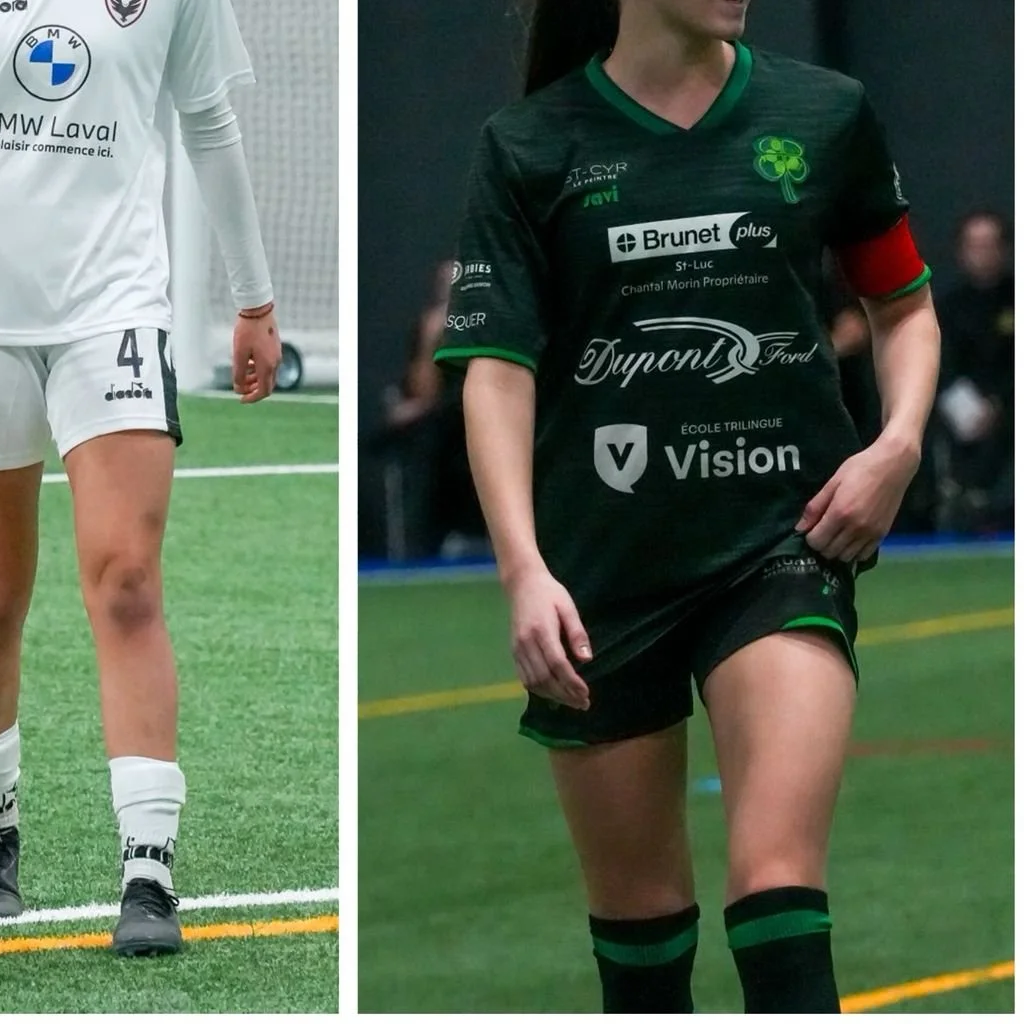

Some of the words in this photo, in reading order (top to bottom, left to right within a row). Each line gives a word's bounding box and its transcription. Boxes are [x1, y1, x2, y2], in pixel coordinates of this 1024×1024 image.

[25, 28, 82, 50] BMW
[51, 115, 118, 142] Laval
[32, 142, 95, 156] commence
[97, 146, 114, 158] ici.
[643, 223, 721, 250] Brunet
[735, 222, 772, 241] plus
[676, 259, 714, 272] St-Luc
[621, 280, 664, 297] Chantal
[667, 278, 701, 291] Morin
[703, 274, 769, 289] Propriétaire
[443, 312, 487, 332] SQUER
[117, 328, 144, 378] 4
[574, 337, 727, 388] Dupont
[758, 342, 819, 366] Ford
[104, 381, 153, 402] diadora
[680, 422, 721, 435] ÉCOLE
[723, 417, 784, 432] TRILINGUE
[606, 442, 635, 472] V
[663, 436, 801, 481] Vision
